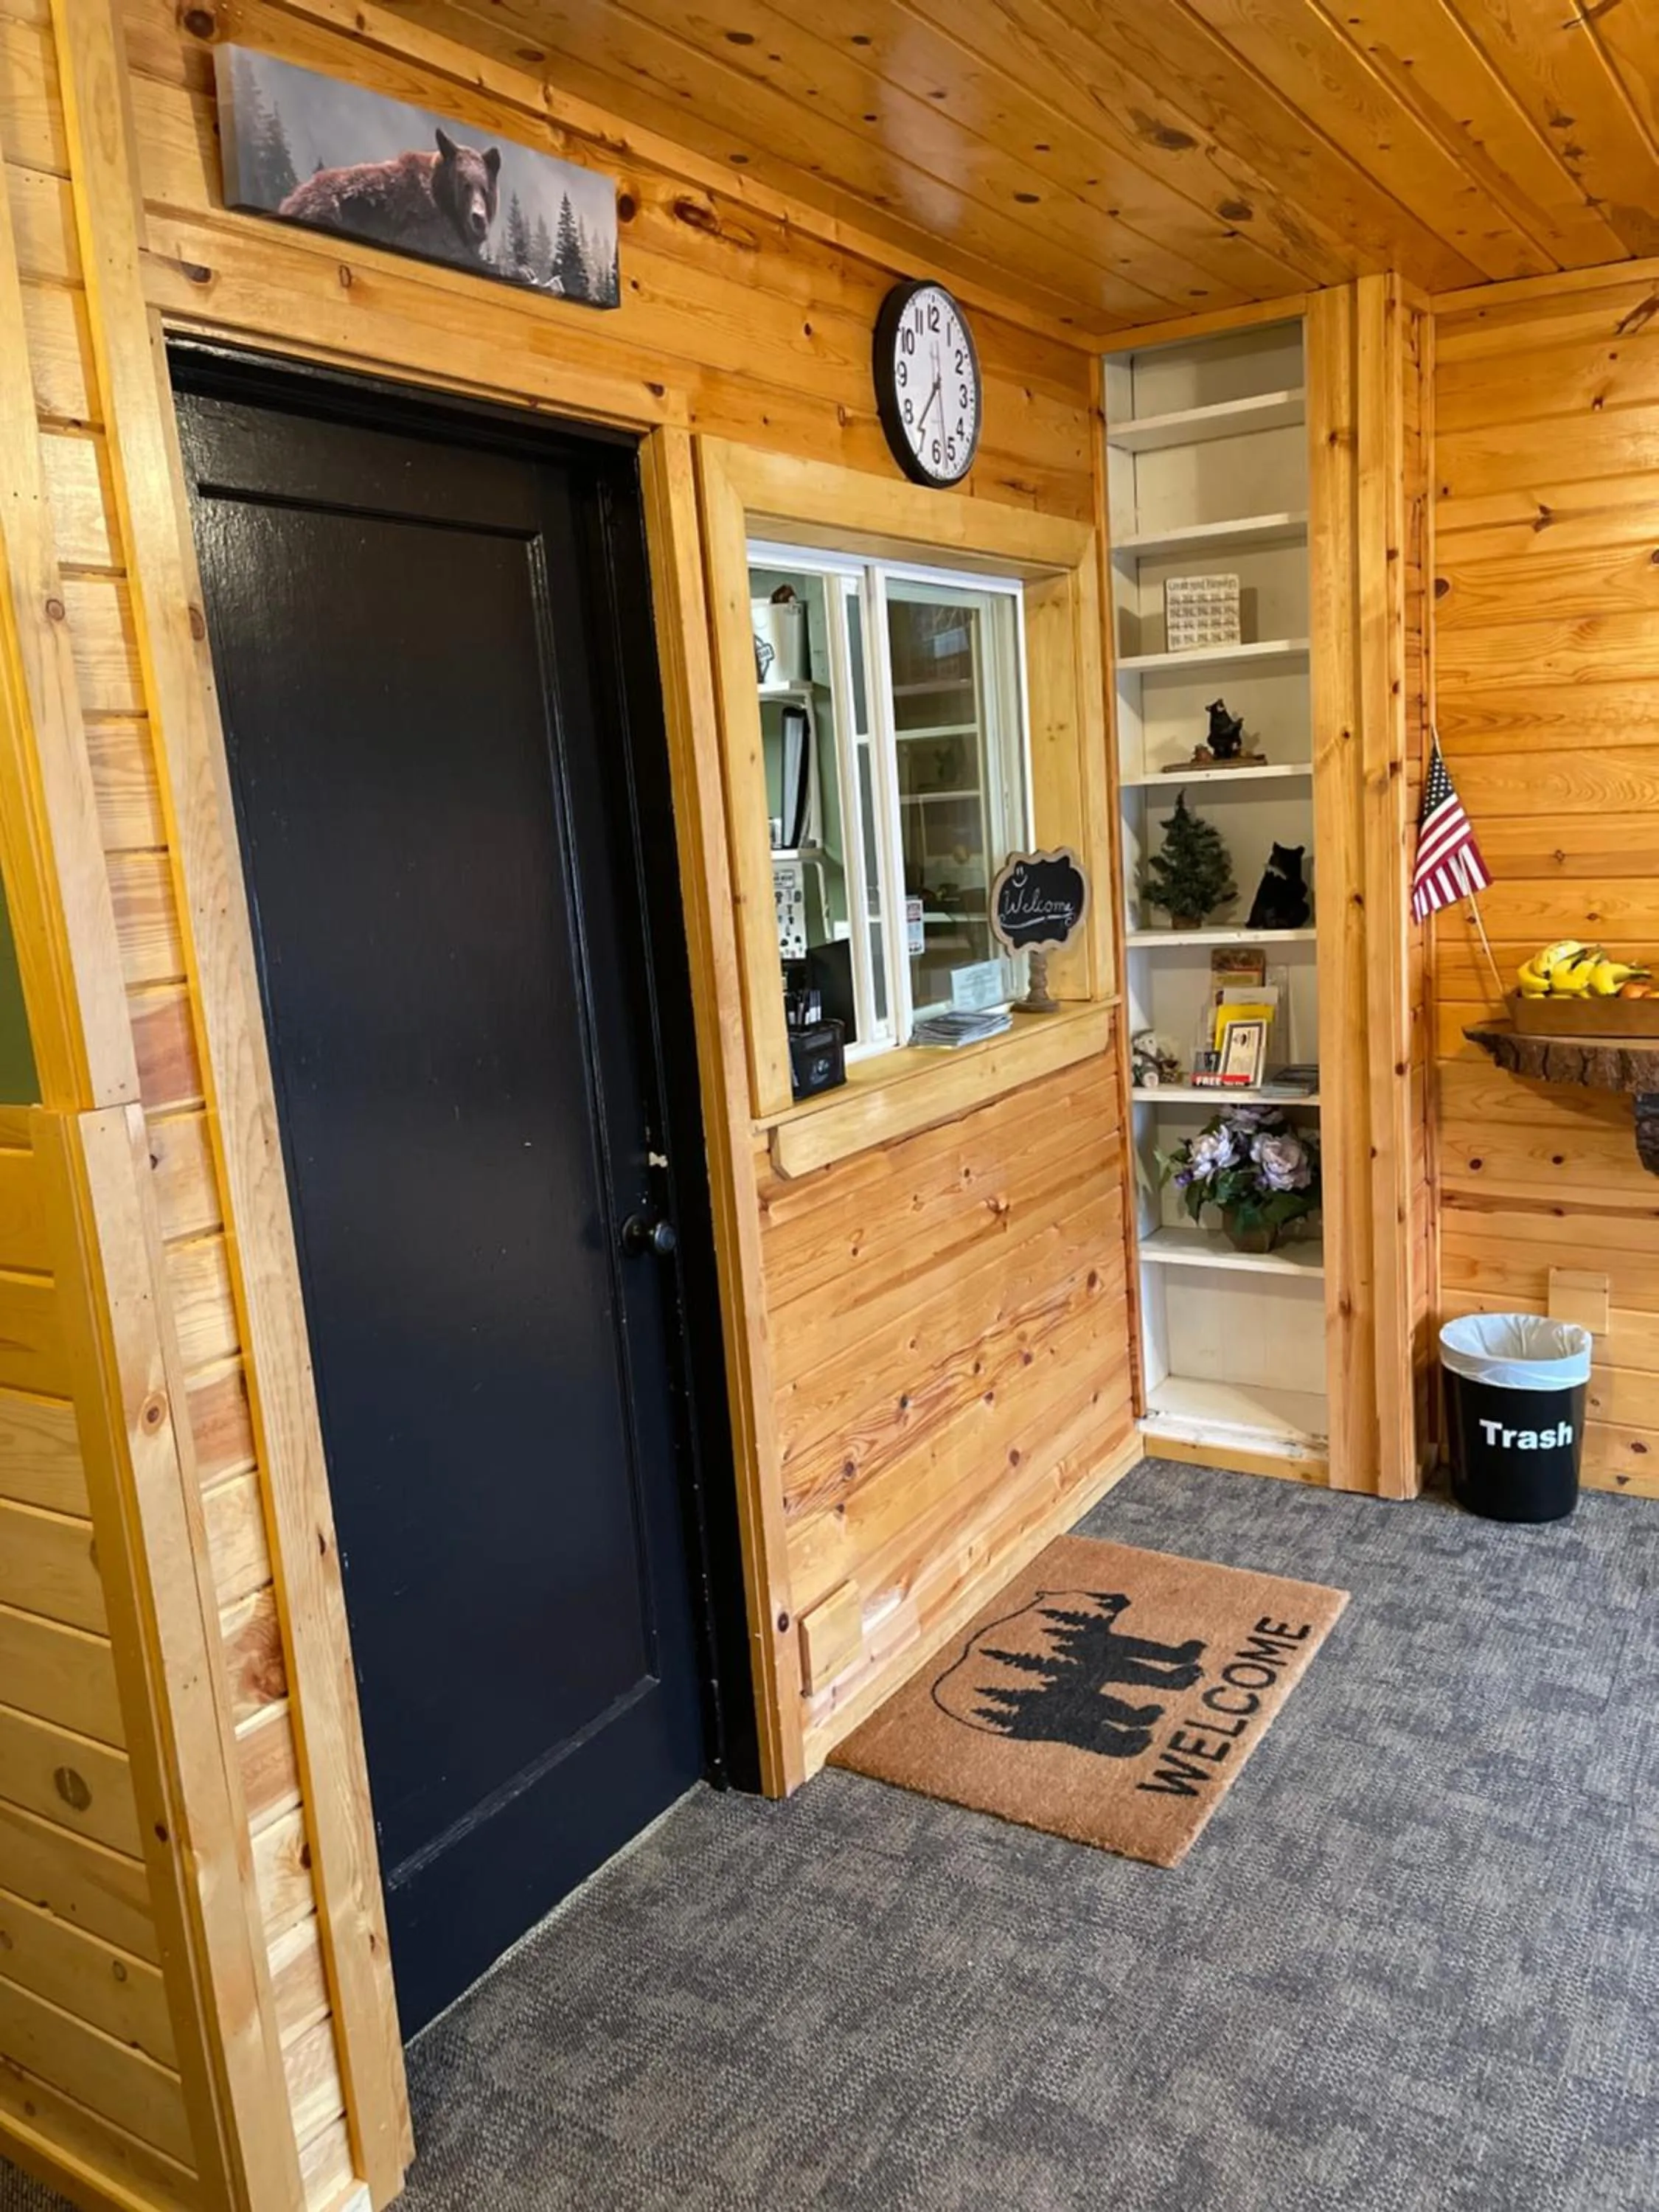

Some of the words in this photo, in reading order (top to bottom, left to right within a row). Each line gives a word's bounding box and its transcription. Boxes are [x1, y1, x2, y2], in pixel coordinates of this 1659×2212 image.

[915, 307, 924, 335] 11
[927, 303, 940, 333] 12
[901, 327, 915, 355] 10
[947, 321, 951, 347] 1
[897, 361, 908, 387] 9
[955, 349, 964, 375] 2
[959, 384, 968, 409] 3
[904, 398, 914, 425] 8
[956, 417, 964, 442] 4
[932, 439, 942, 465] 6
[947, 437, 956, 461] 5
[1003, 887, 1074, 915] Welcome
[1195, 1075, 1222, 1087] FREE
[1479, 1419, 1573, 1450] Trash
[1136, 1616, 1311, 1796] WELCOME
